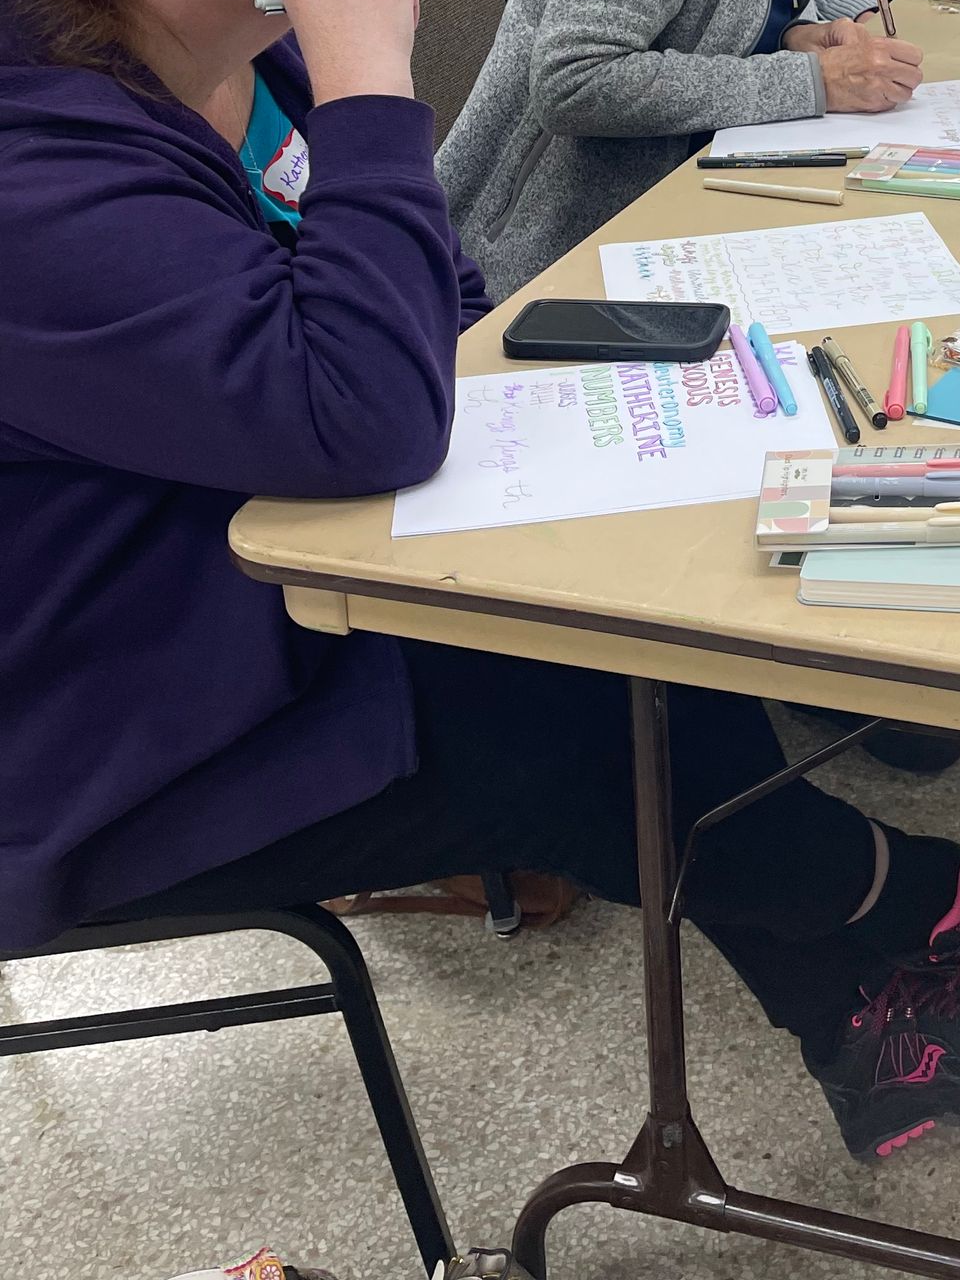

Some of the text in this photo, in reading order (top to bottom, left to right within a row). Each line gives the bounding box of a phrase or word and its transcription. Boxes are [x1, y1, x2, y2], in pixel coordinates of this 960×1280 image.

[580, 365, 625, 448] NUMBERS
[616, 363, 667, 463] KATHERINE
[652, 361, 687, 449] deuteronomy
[709, 353, 741, 408] GENESIS
